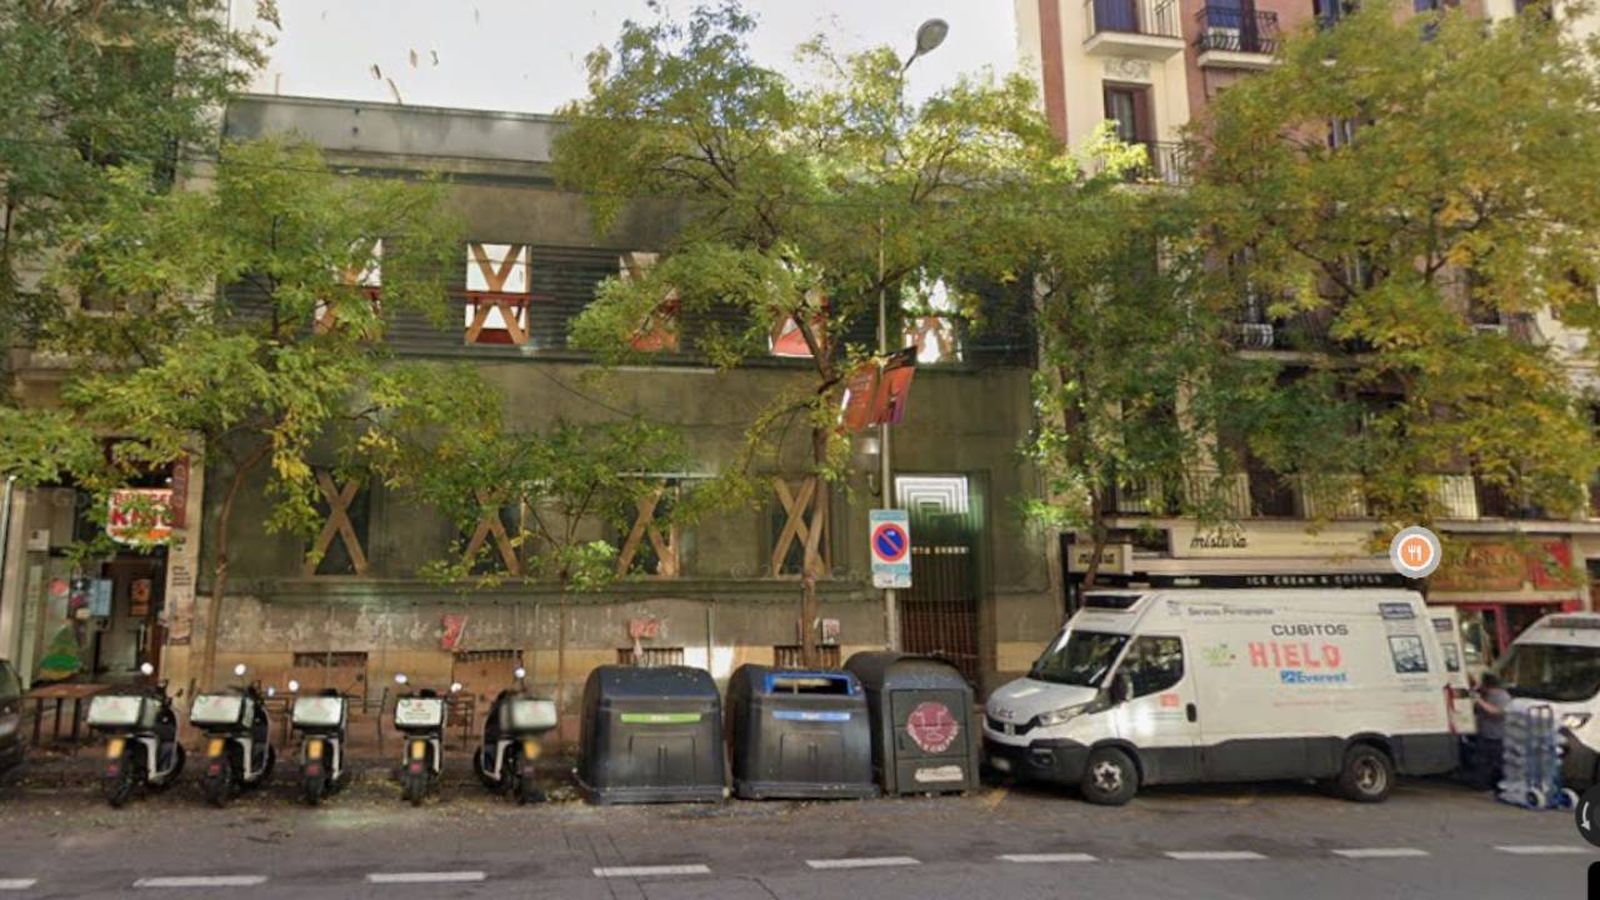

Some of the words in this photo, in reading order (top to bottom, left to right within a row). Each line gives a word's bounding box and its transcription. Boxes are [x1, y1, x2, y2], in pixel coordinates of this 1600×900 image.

[1271, 624, 1349, 636] CUBITOS
[1247, 641, 1341, 668] HIELO
[1296, 671, 1346, 683] Everest
